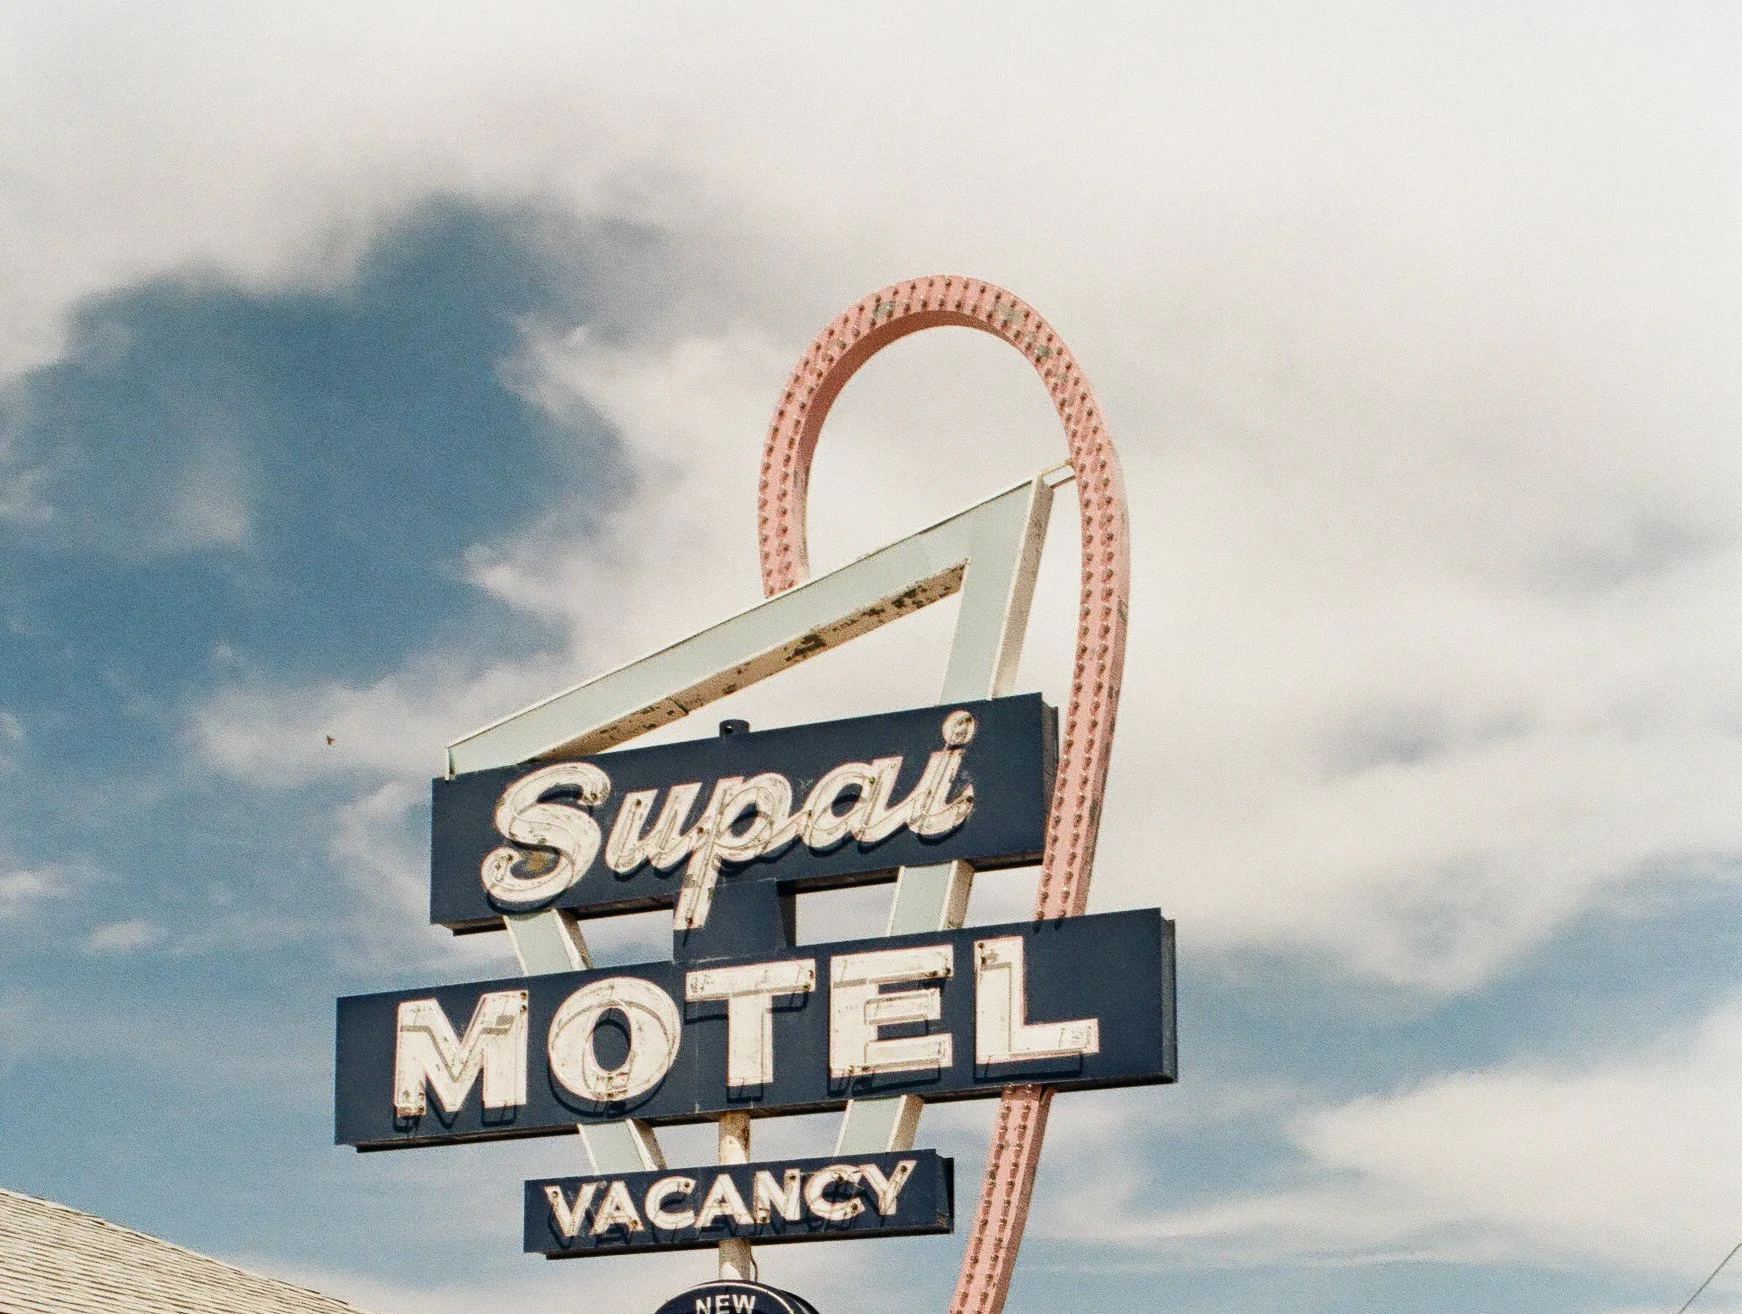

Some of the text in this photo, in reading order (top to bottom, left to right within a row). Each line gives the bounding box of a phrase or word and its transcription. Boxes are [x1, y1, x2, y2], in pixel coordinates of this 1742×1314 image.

[481, 710, 976, 929] Supai
[393, 936, 1100, 1118] MOTEL
[544, 1160, 917, 1237] VACANCY
